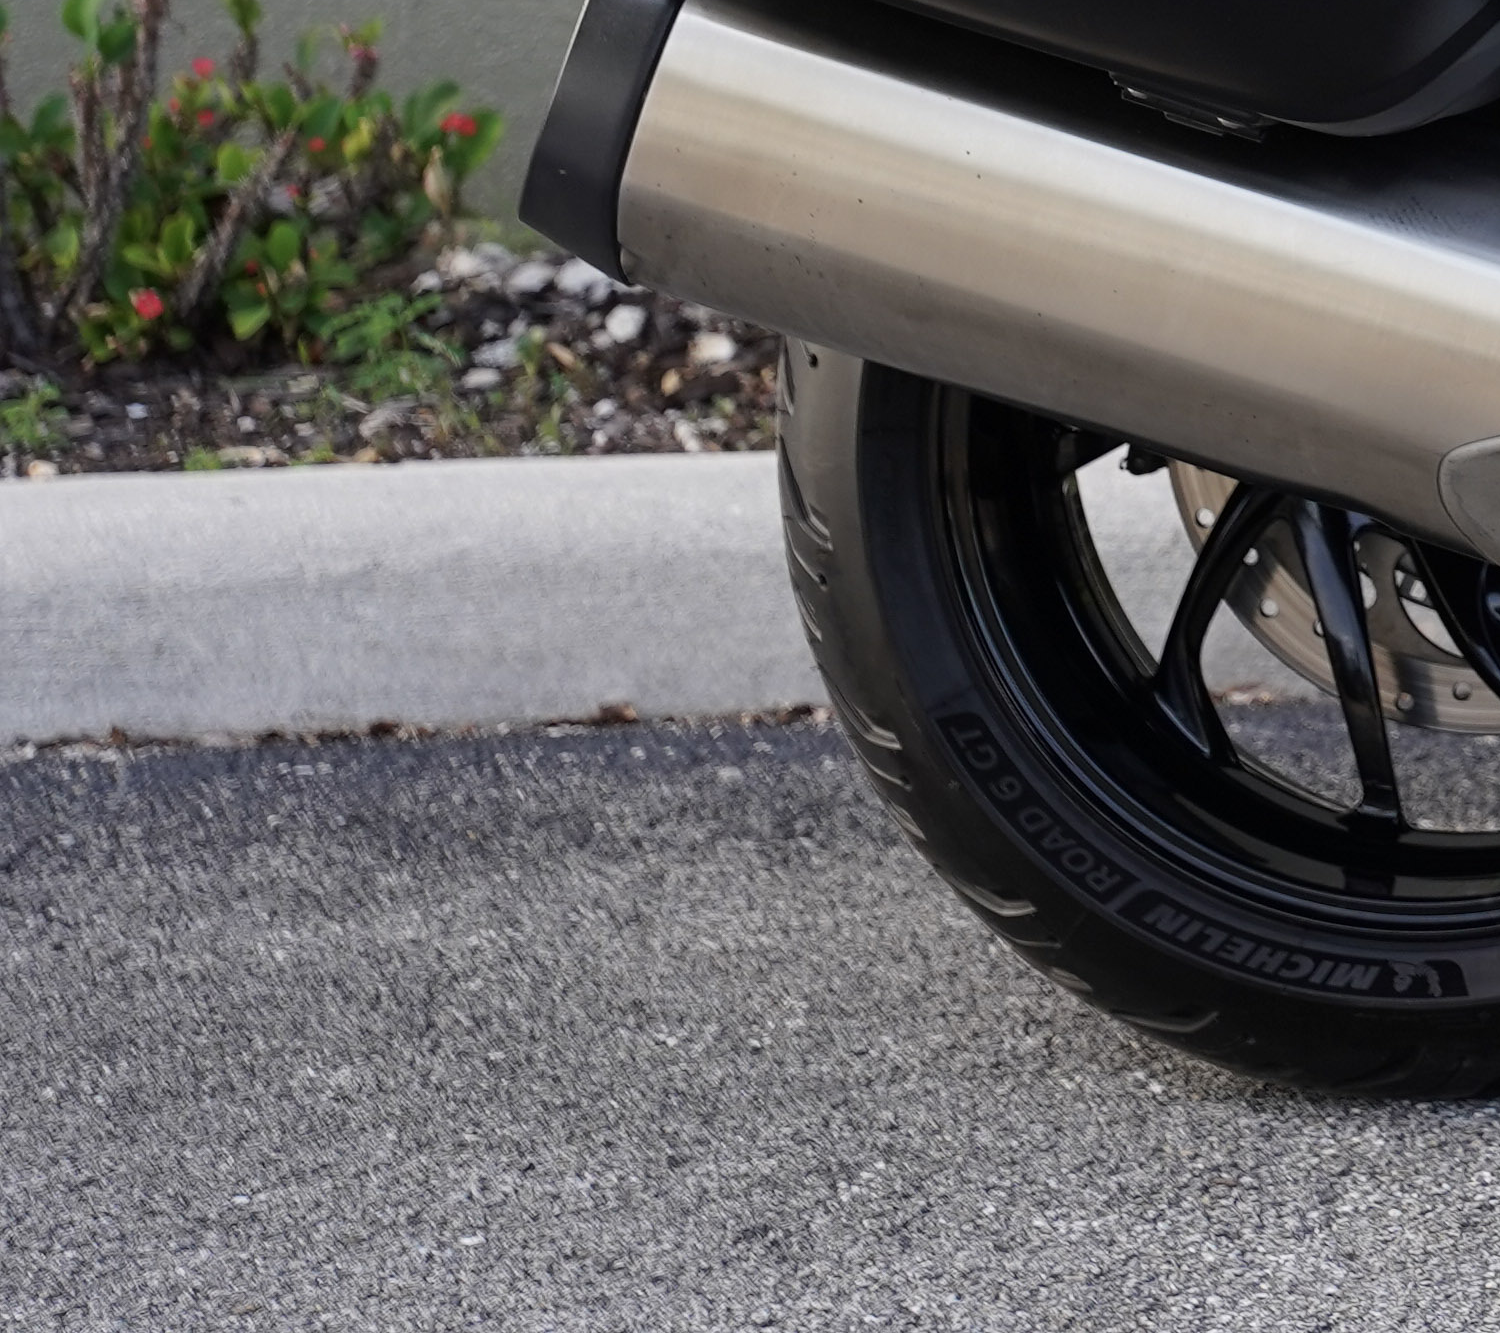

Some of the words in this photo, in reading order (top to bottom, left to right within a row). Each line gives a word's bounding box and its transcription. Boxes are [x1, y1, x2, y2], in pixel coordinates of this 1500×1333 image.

[951, 727, 998, 770] GT
[989, 778, 1021, 798] 6
[1021, 805, 1125, 895] ROAD
[1146, 906, 1378, 991] MICHELIN
